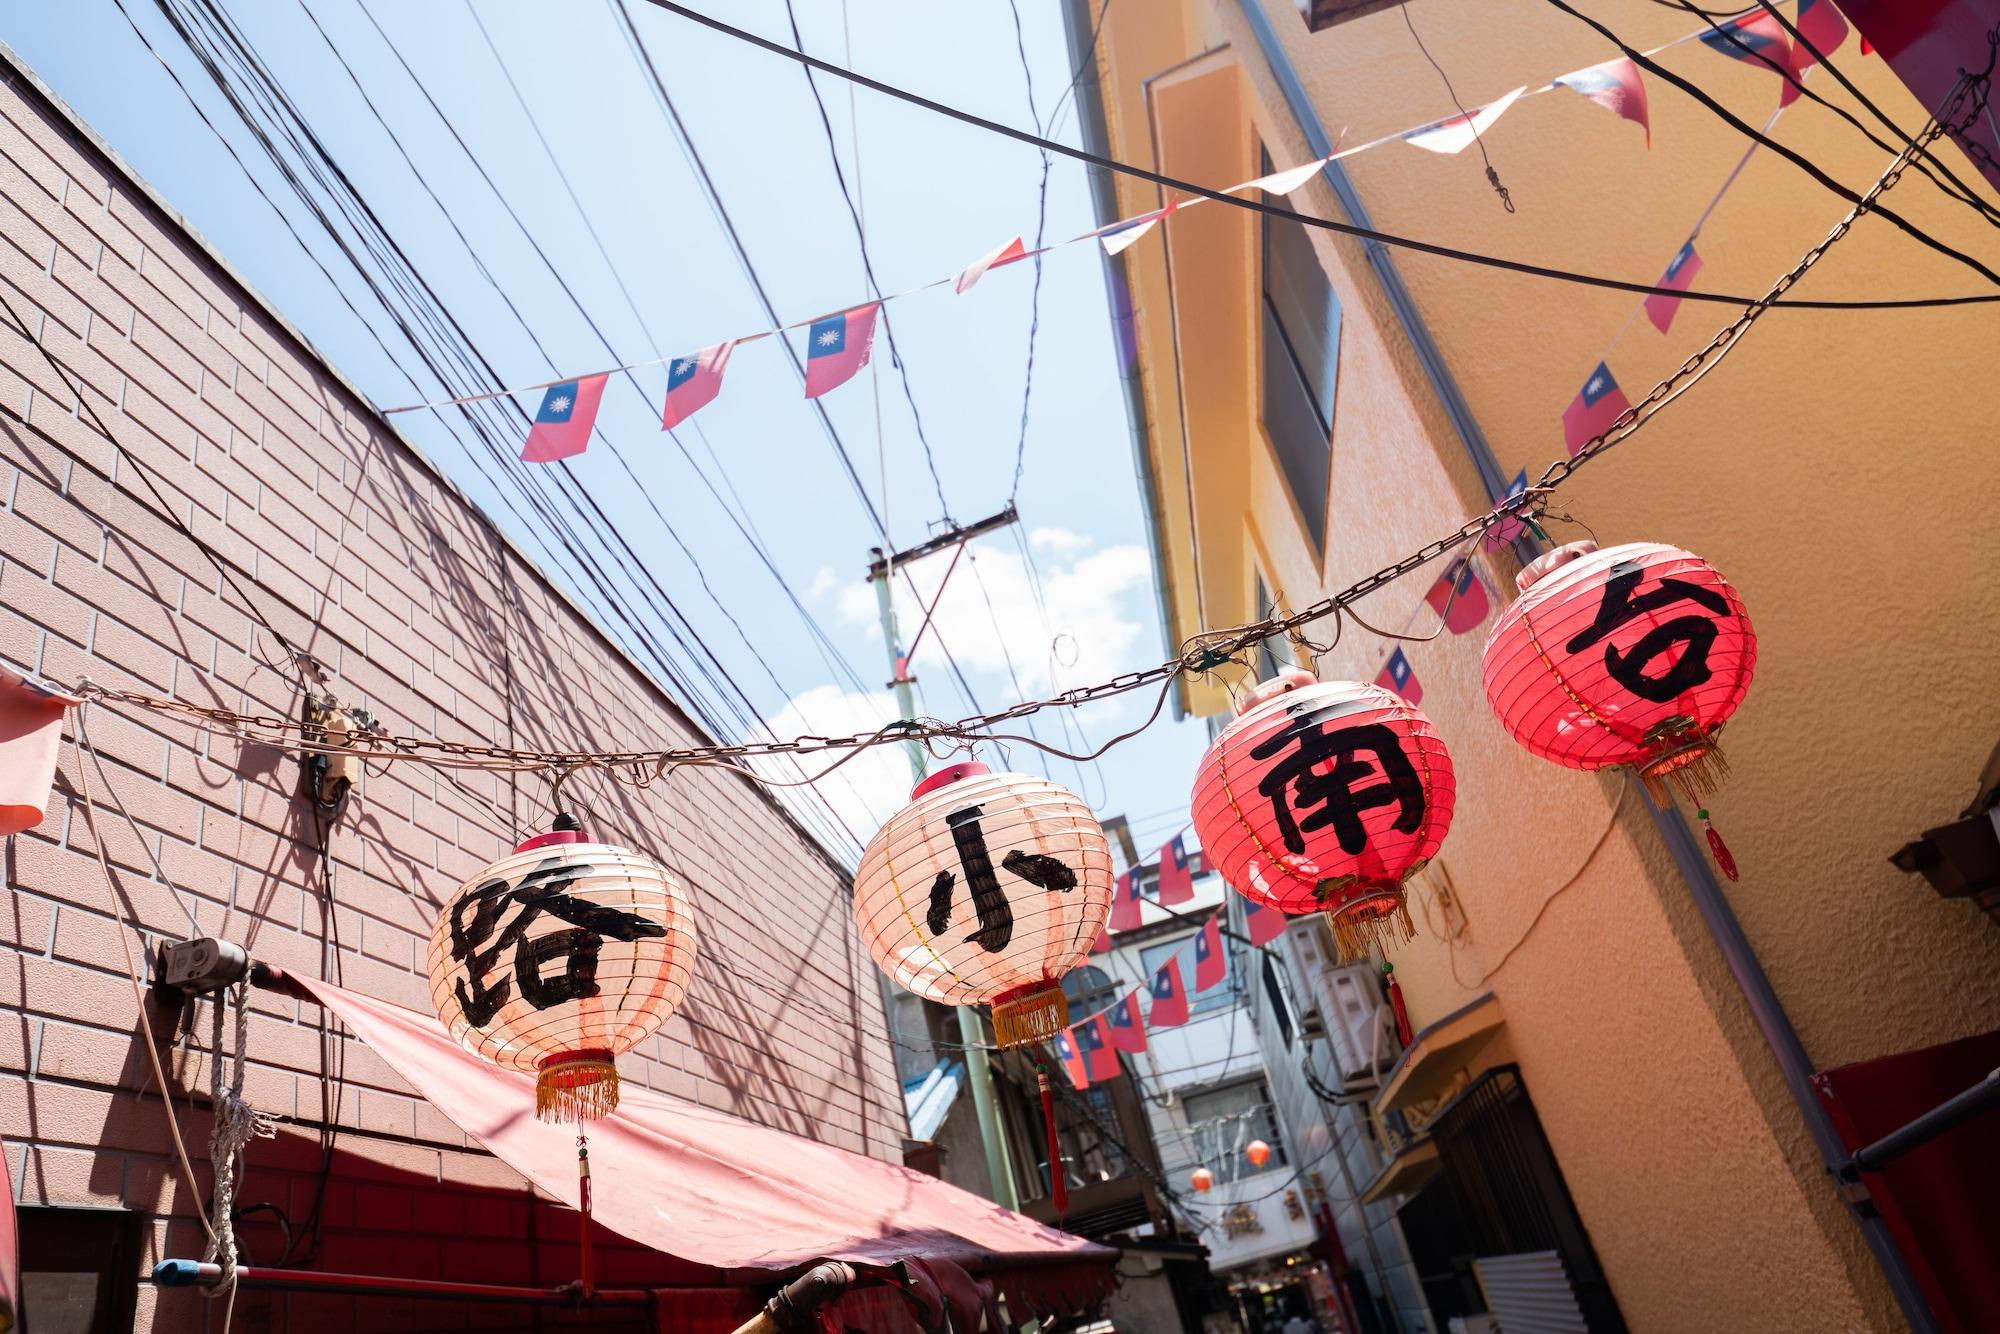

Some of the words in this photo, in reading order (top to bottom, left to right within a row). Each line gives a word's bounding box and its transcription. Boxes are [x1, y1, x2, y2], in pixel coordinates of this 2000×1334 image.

[1566, 561, 1732, 703] 台
[1250, 702, 1426, 855] 南
[450, 856, 668, 1028] 路
[927, 802, 1078, 953] 小
